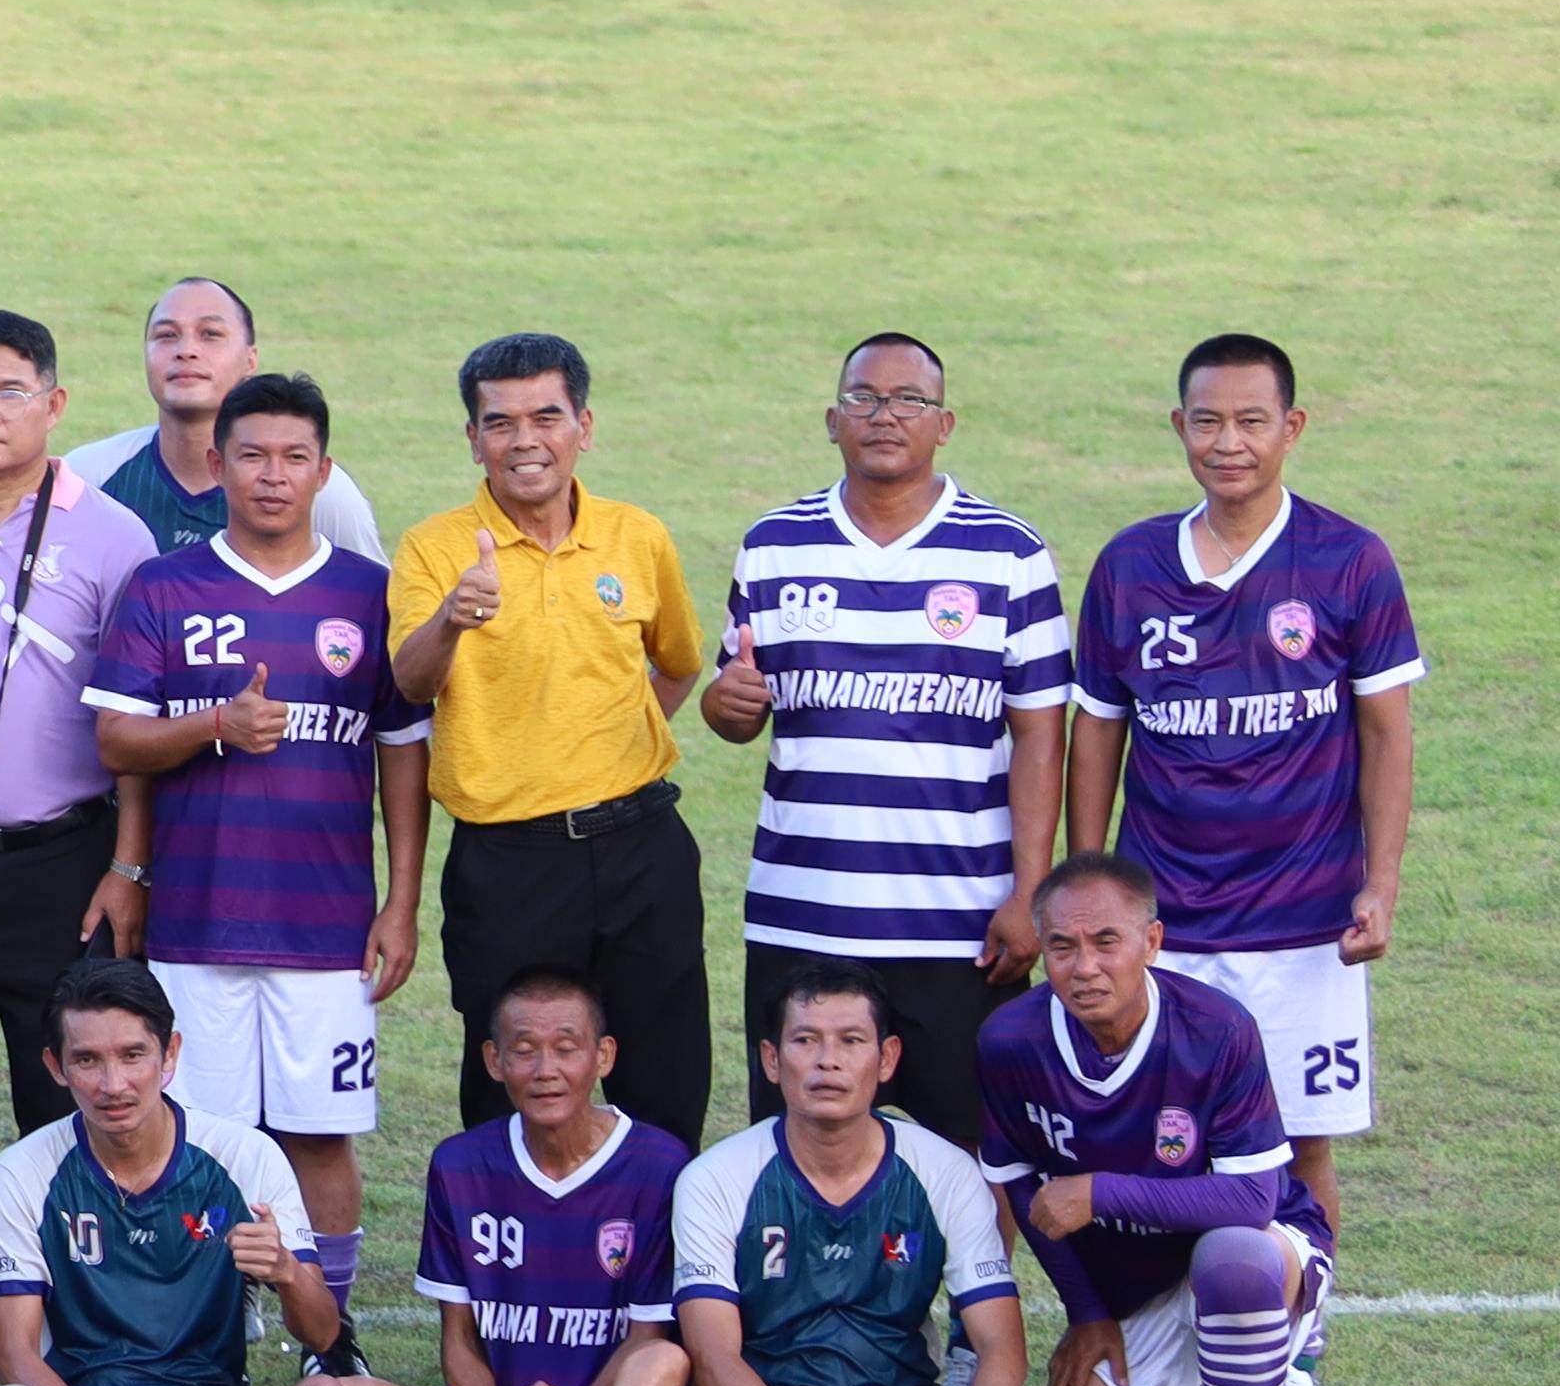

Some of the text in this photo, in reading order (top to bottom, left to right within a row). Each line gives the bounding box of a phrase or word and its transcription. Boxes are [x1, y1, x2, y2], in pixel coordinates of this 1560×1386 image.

[778, 582, 838, 633] 88
[184, 614, 246, 666] 22
[1140, 614, 1197, 670] 25
[284, 701, 331, 742] REE
[1227, 692, 1296, 737] TREE
[332, 1037, 375, 1093] 22
[1304, 1037, 1360, 1096] 25
[1024, 1101, 1079, 1161] 42
[59, 1210, 104, 1266] 10
[471, 1211, 524, 1270] 99
[761, 1225, 789, 1281] 2
[473, 1300, 538, 1345] NANA
[547, 1304, 613, 1348] TREE
